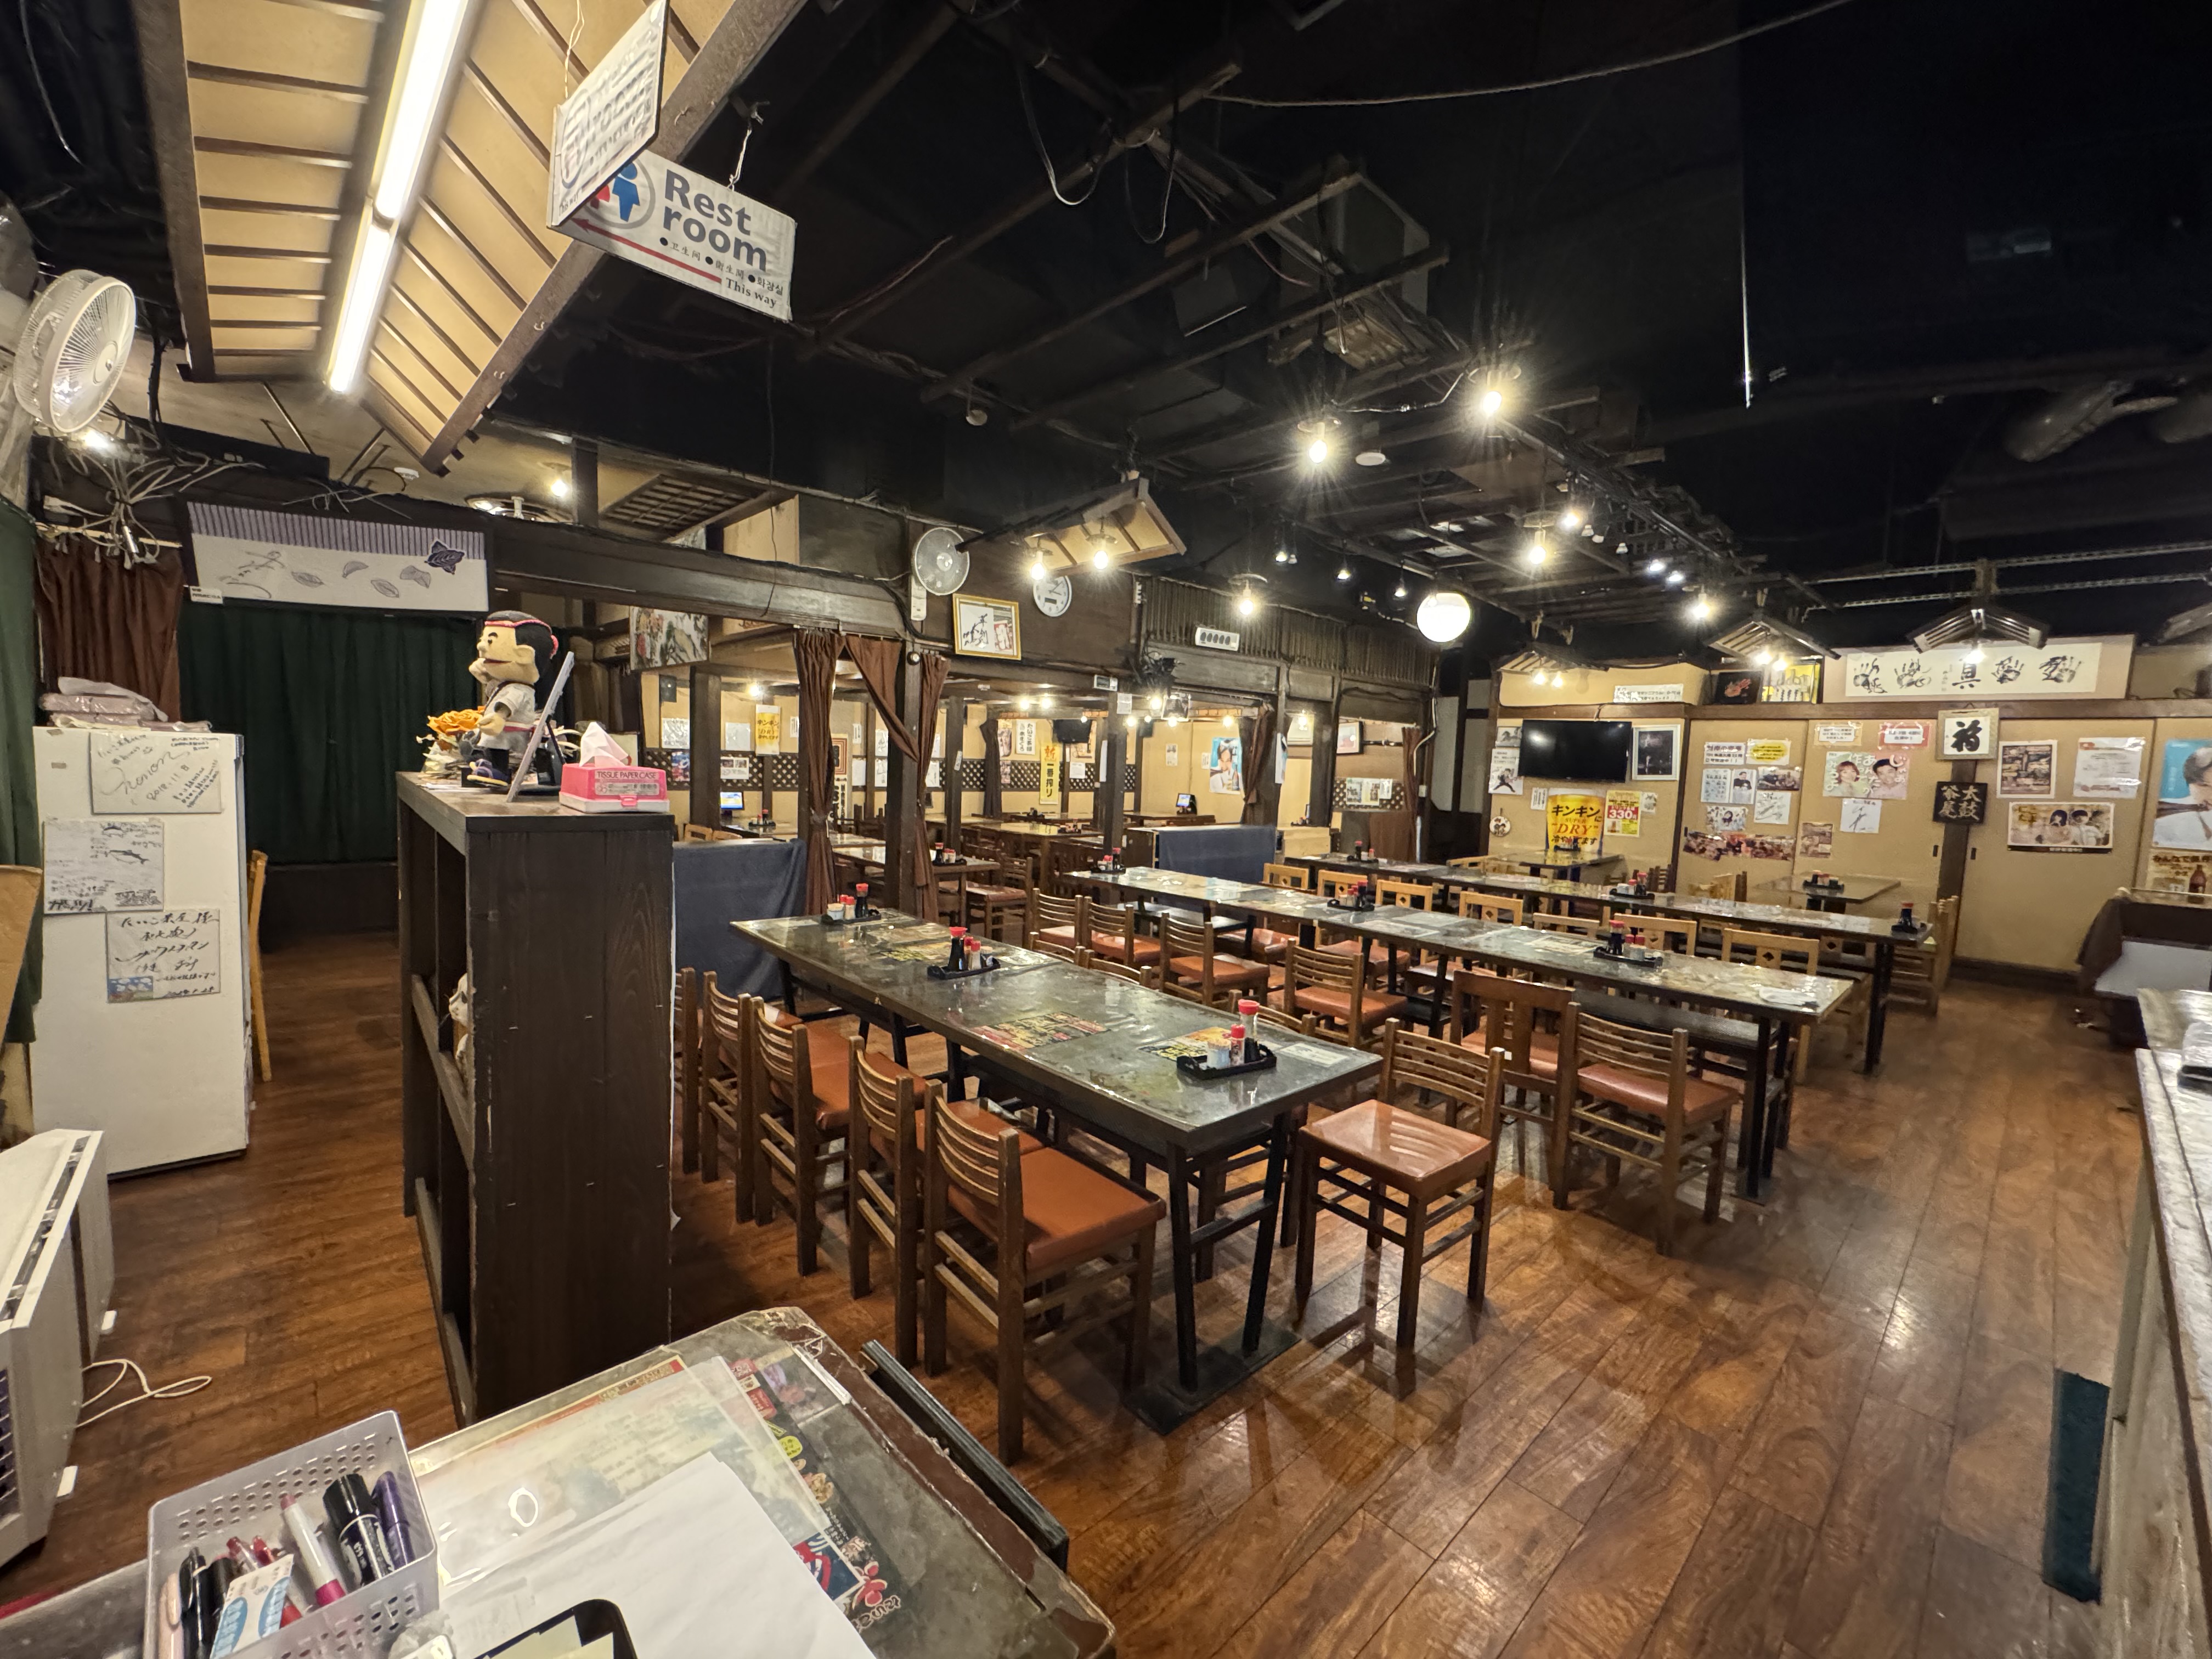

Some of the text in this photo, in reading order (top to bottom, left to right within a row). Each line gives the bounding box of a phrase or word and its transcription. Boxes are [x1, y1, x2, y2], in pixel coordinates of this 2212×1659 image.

[665, 168, 752, 236] Rest
[663, 205, 767, 273] room
[726, 276, 777, 309] This way
[757, 276, 783, 296] 화장실
